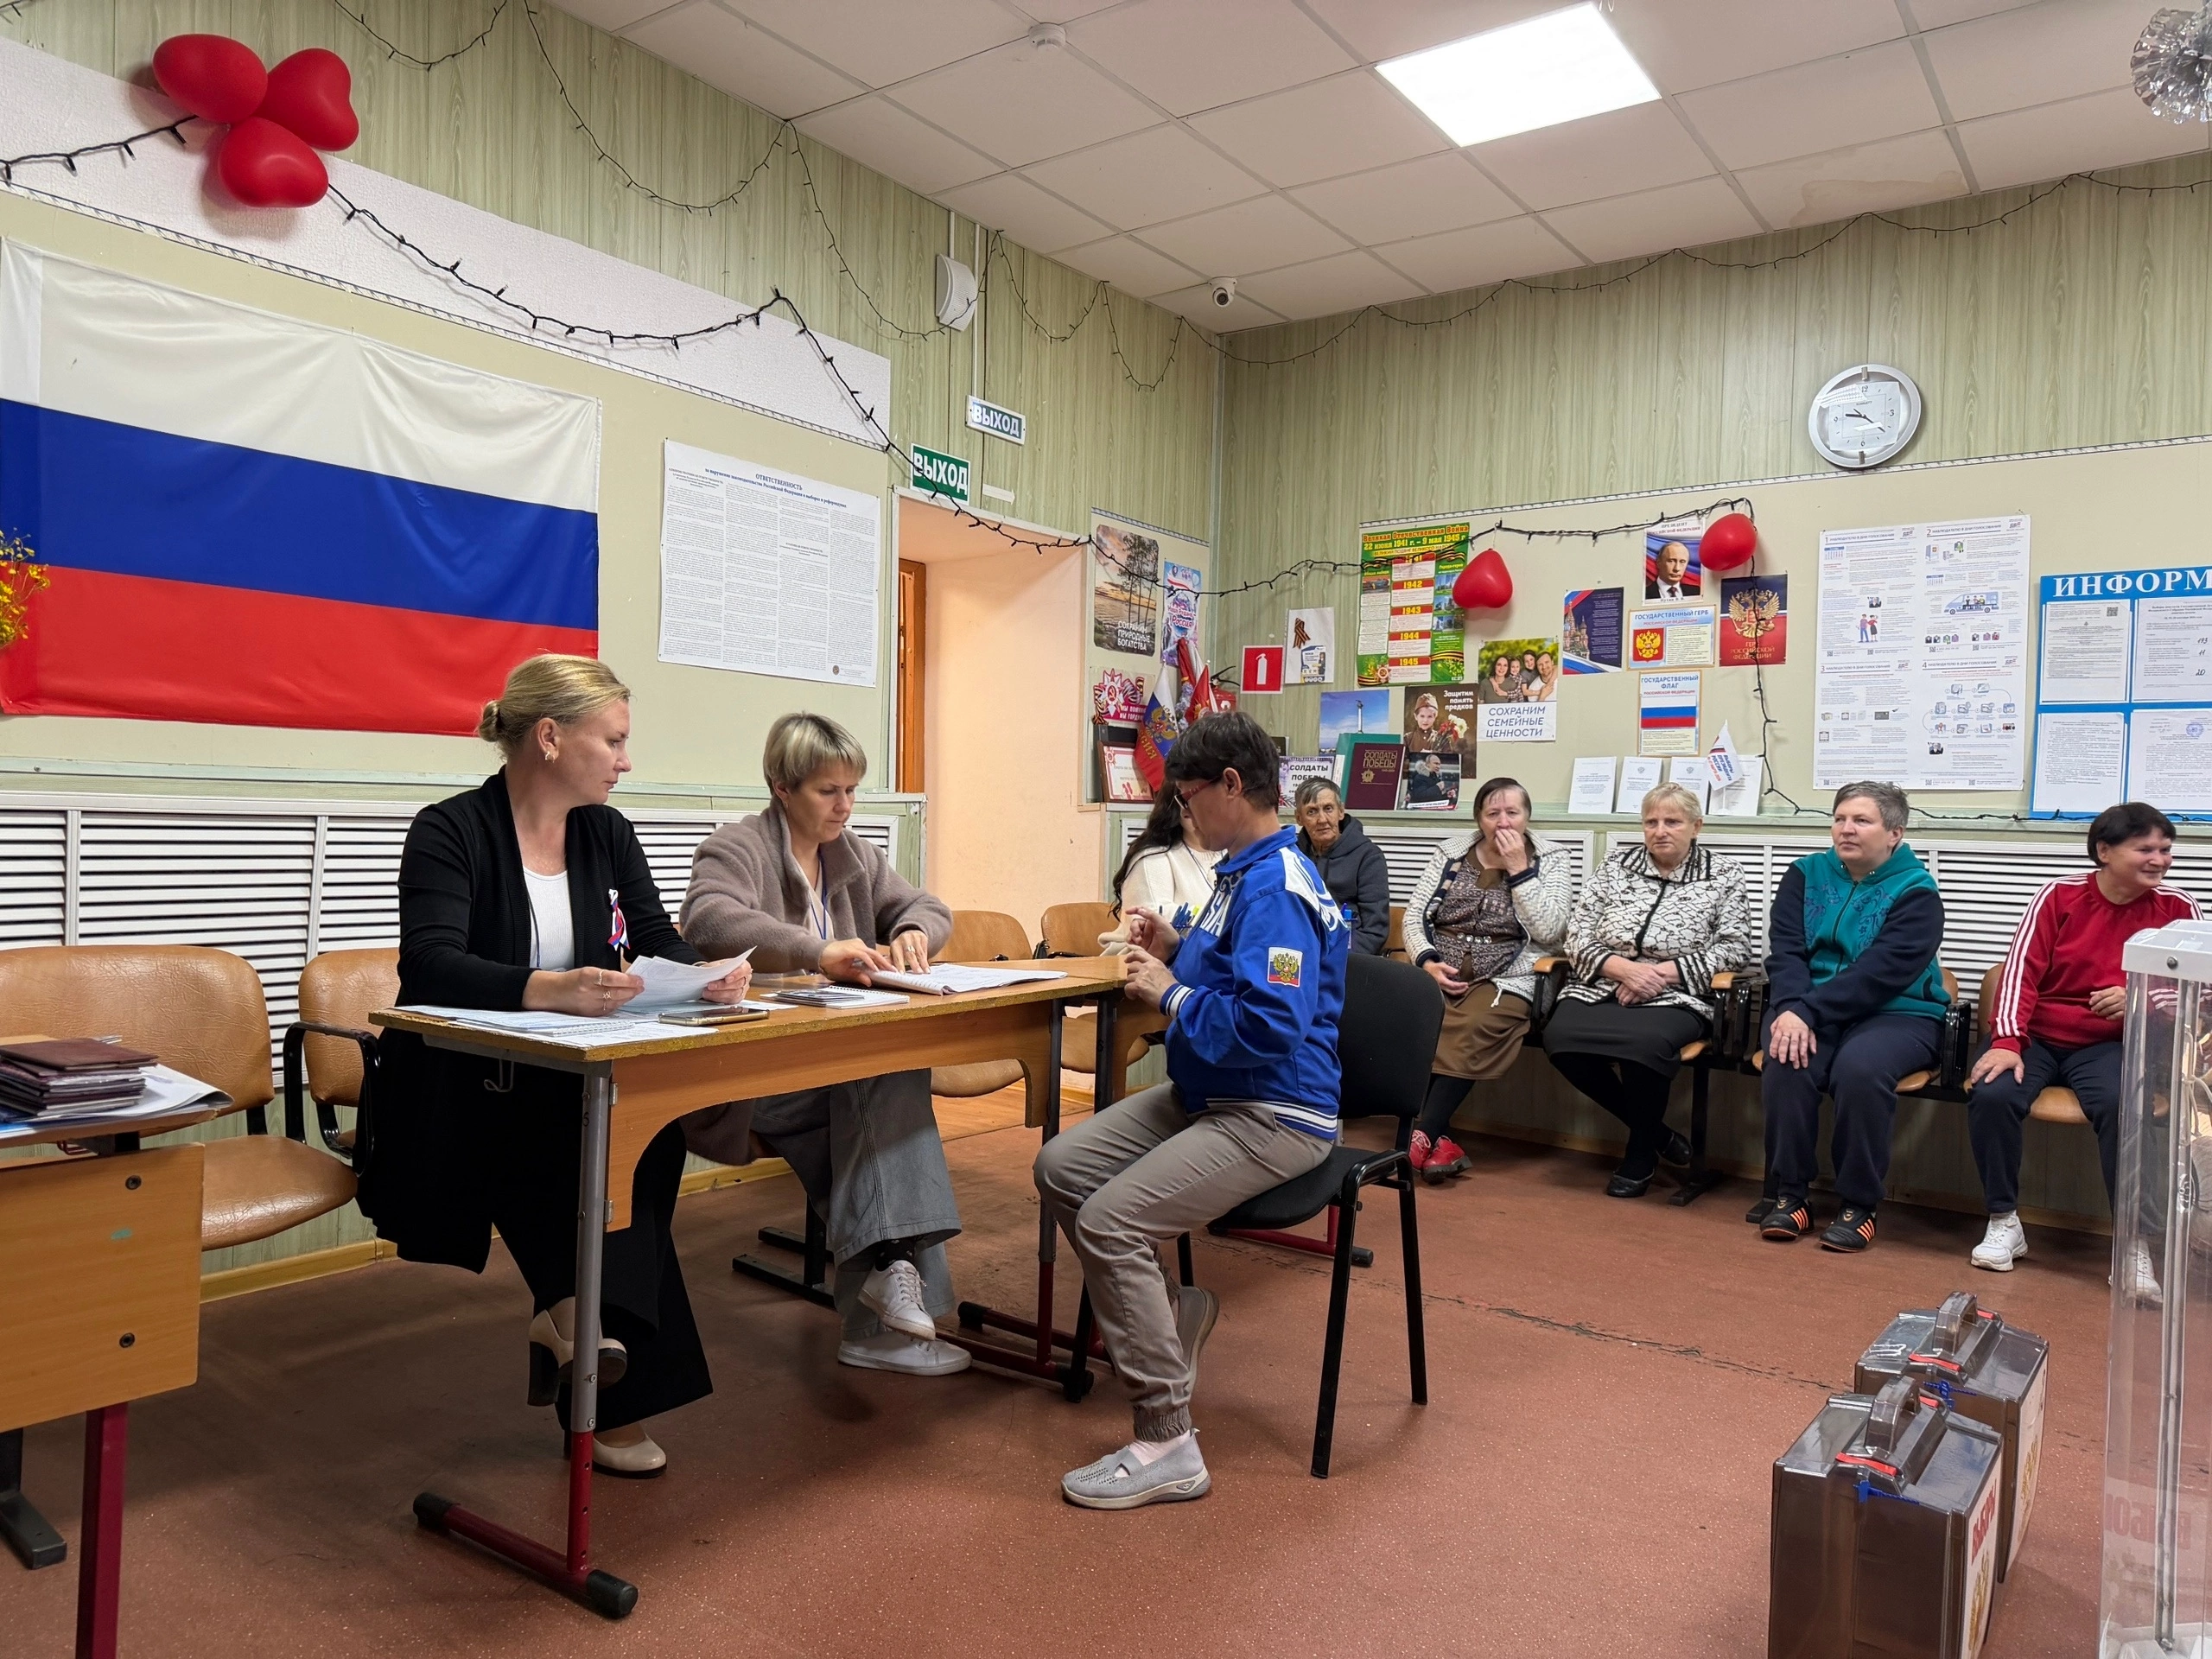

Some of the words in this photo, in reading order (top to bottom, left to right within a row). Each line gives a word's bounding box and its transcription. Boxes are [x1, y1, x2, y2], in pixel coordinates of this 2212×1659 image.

[973, 404, 1019, 436] ВЫХОД
[913, 452, 968, 496] ВЫХОД
[755, 473, 803, 491] ОТВЕТСТВЕННОСТЬ
[1363, 534, 1391, 543] Великая
[1392, 528, 1444, 539] Отечественная
[1446, 524, 1468, 533] Война
[1394, 539, 1408, 547] 1941
[1403, 580, 1423, 589] 1942
[2053, 569, 2212, 597] ИНФОРМ
[1402, 607, 1421, 615] 1943
[1635, 611, 1693, 620] ГОСУДАРСТВЕННЫЙ
[1118, 621, 1147, 633] СОХРАНИМ
[1117, 629, 1150, 643] ПРИРОДНЫЕ
[1117, 638, 1147, 650] БОГАТСТВА
[1641, 675, 1698, 683] ГОСУДАРСТВЕННЫЙ
[1489, 706, 1546, 716] СОХРАНИМ
[1488, 716, 1544, 727] СЕМЕЙНЫЕ
[1486, 728, 1542, 738] ЦЕННОСТИ
[1363, 758, 1396, 768] ПОБЕДЫ
